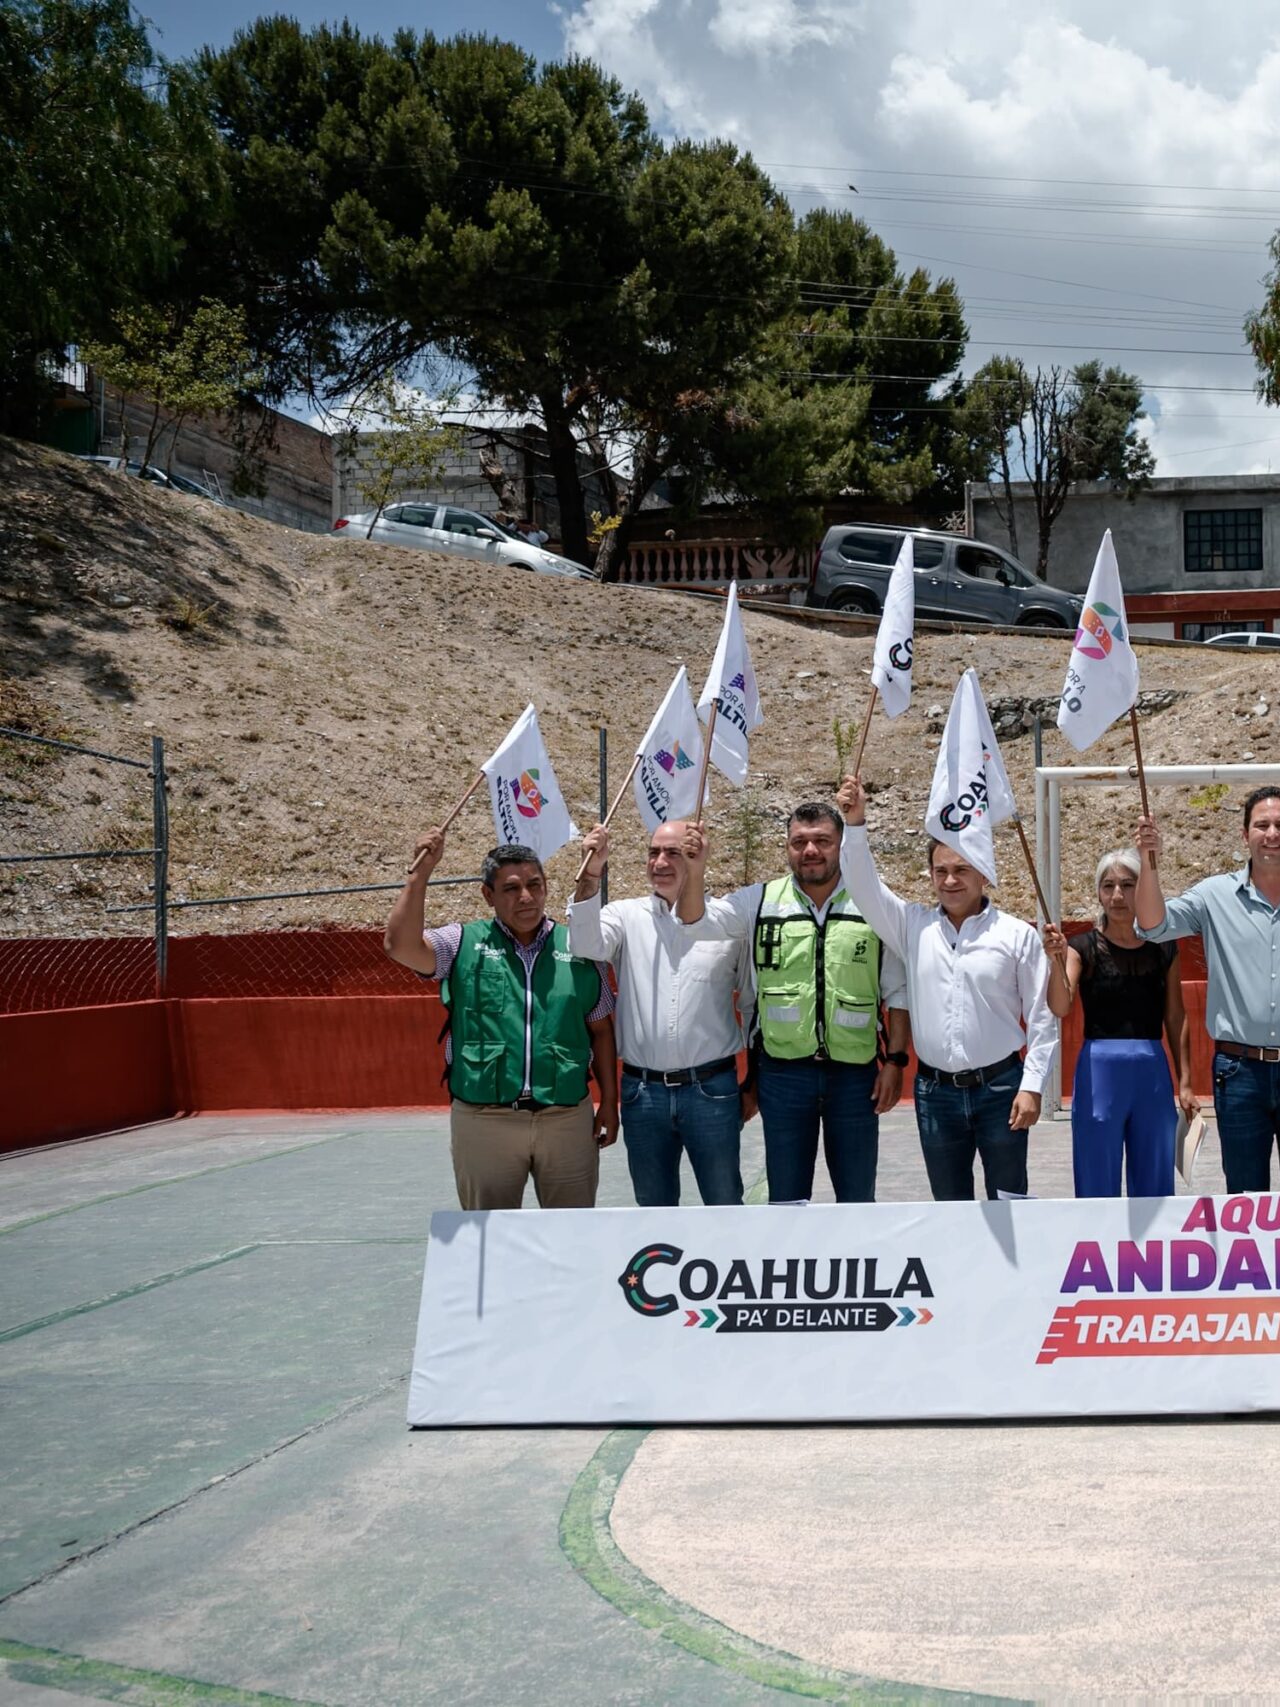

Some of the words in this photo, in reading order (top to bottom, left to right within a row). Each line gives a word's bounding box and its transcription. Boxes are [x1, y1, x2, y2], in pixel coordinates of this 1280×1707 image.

[1062, 686, 1082, 713] LO
[618, 1242, 935, 1317] COAHUILA
[776, 1307, 878, 1327] DELANTE
